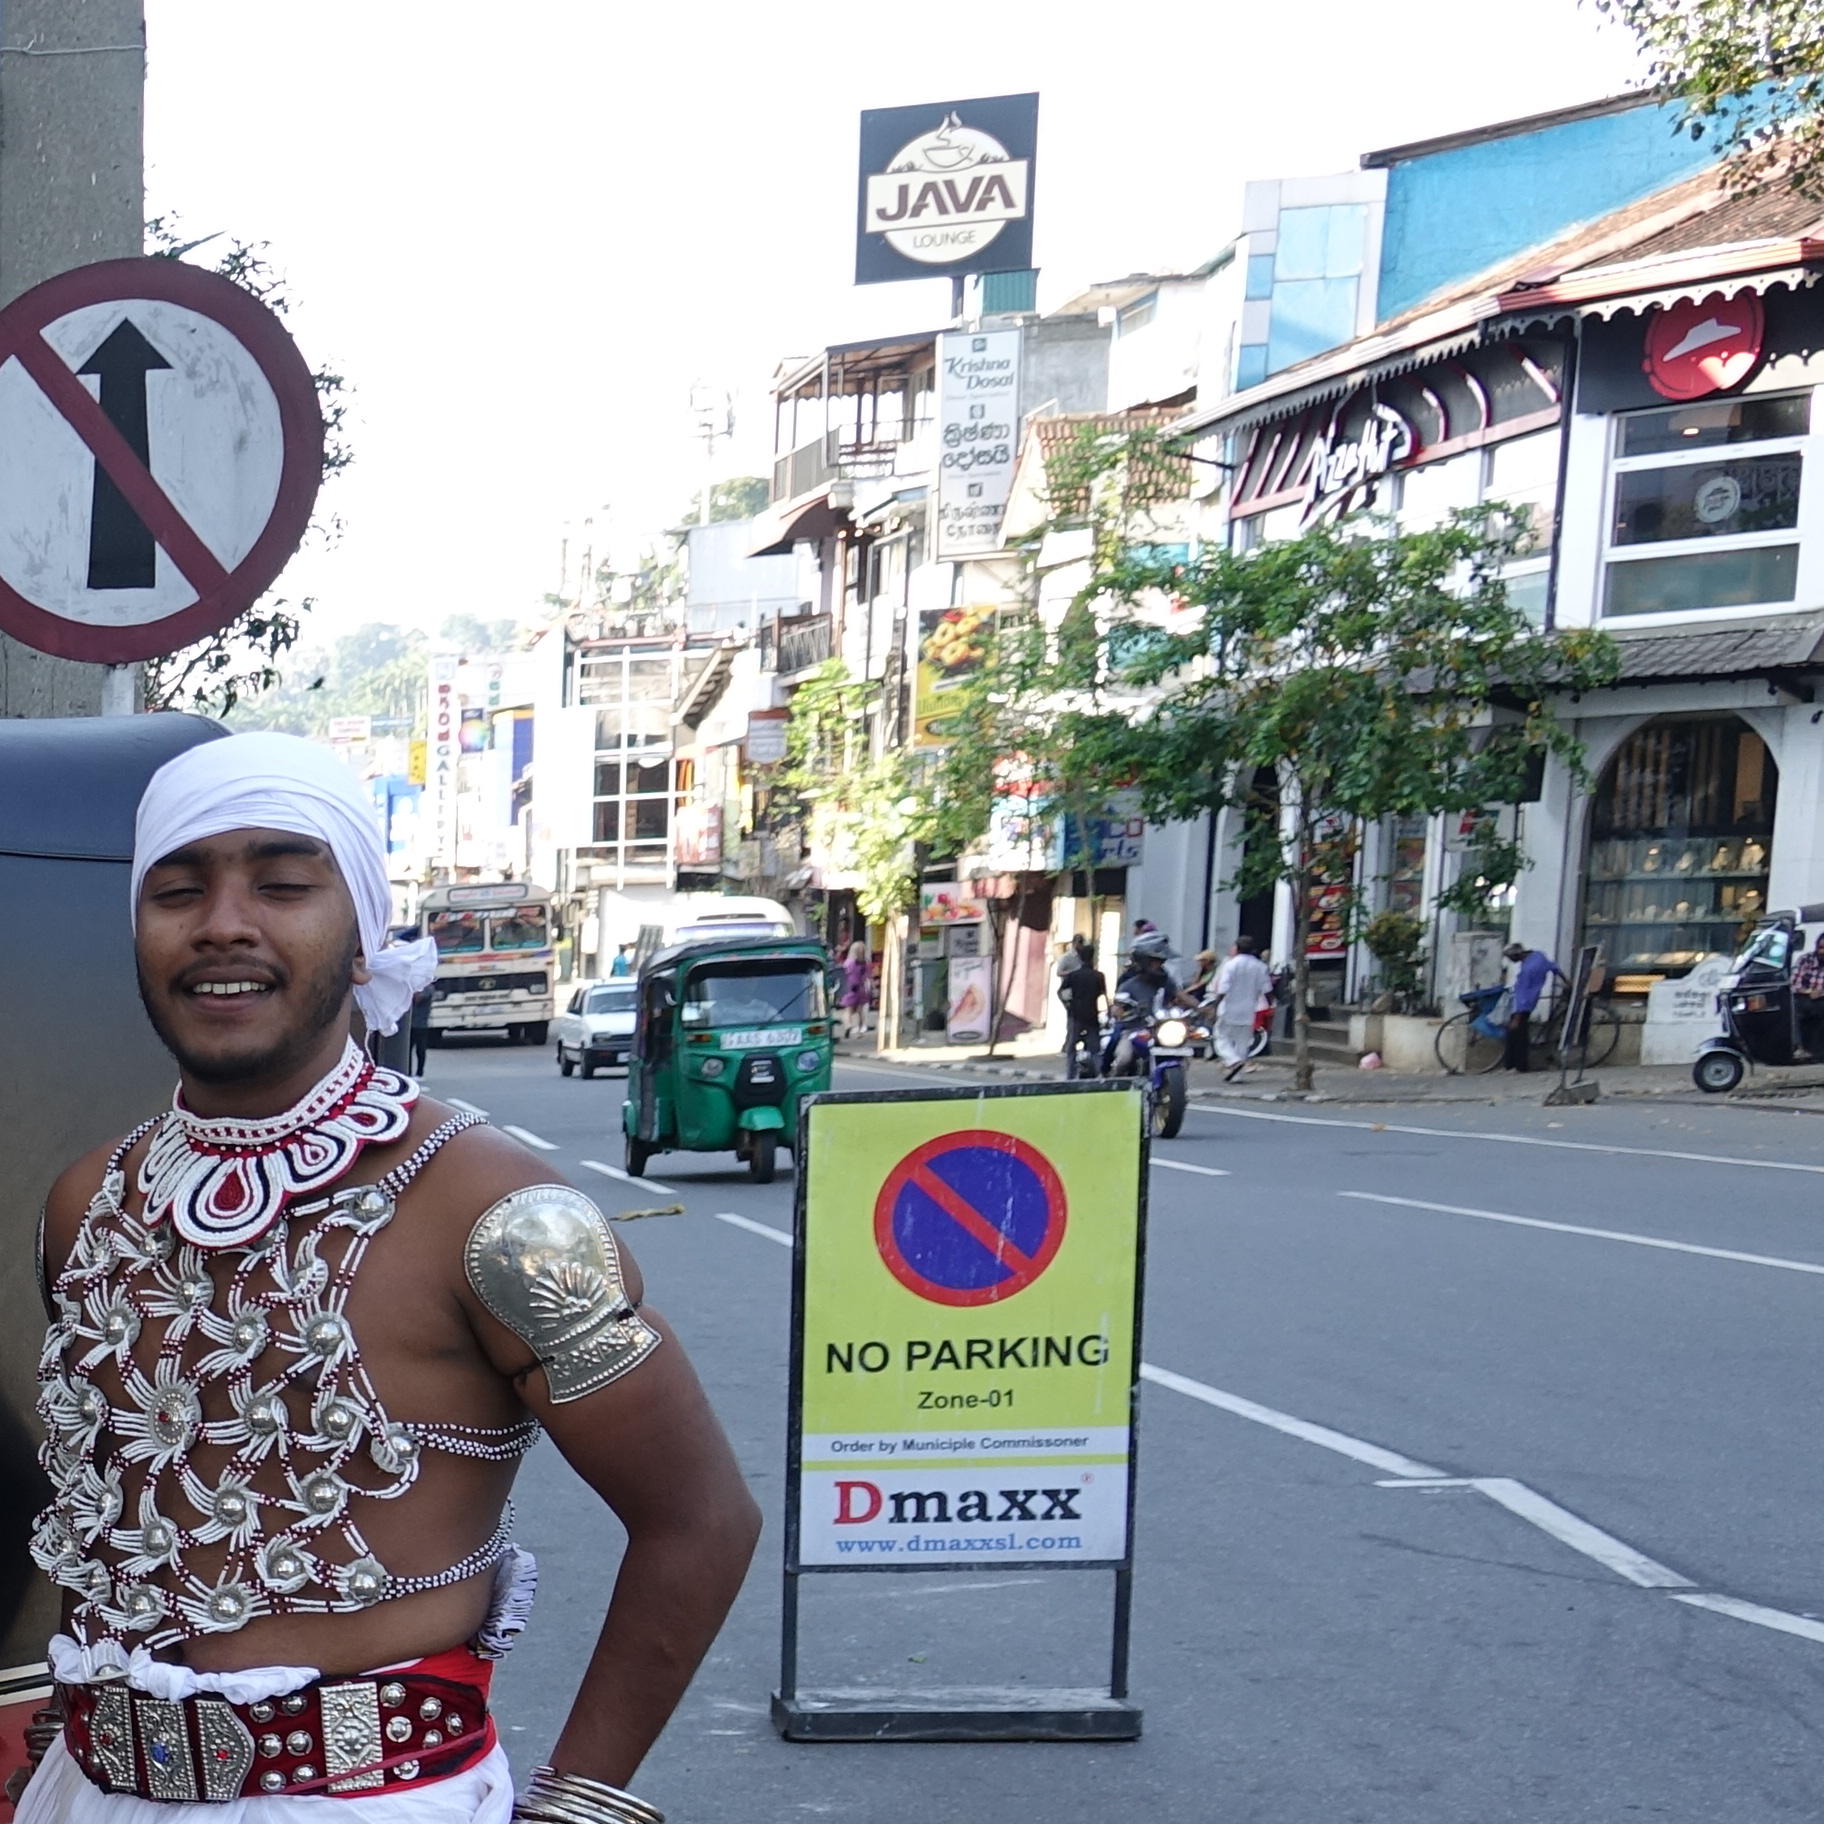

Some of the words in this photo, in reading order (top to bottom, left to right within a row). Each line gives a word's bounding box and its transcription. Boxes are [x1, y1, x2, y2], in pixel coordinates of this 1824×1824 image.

[875, 174, 1017, 222] JAVA
[913, 230, 976, 249] LOUNGE
[944, 357, 1011, 379] Krishna
[826, 1341, 890, 1374] NO
[906, 1334, 1109, 1372] PARKING
[917, 1389, 1014, 1410] Zone-01
[831, 1440, 873, 1453] Order
[879, 1439, 897, 1454] by
[903, 1436, 976, 1452] Municiple
[833, 1480, 1082, 1525] Dmaxx
[836, 1533, 1082, 1553] www.dmaxxsl.com
